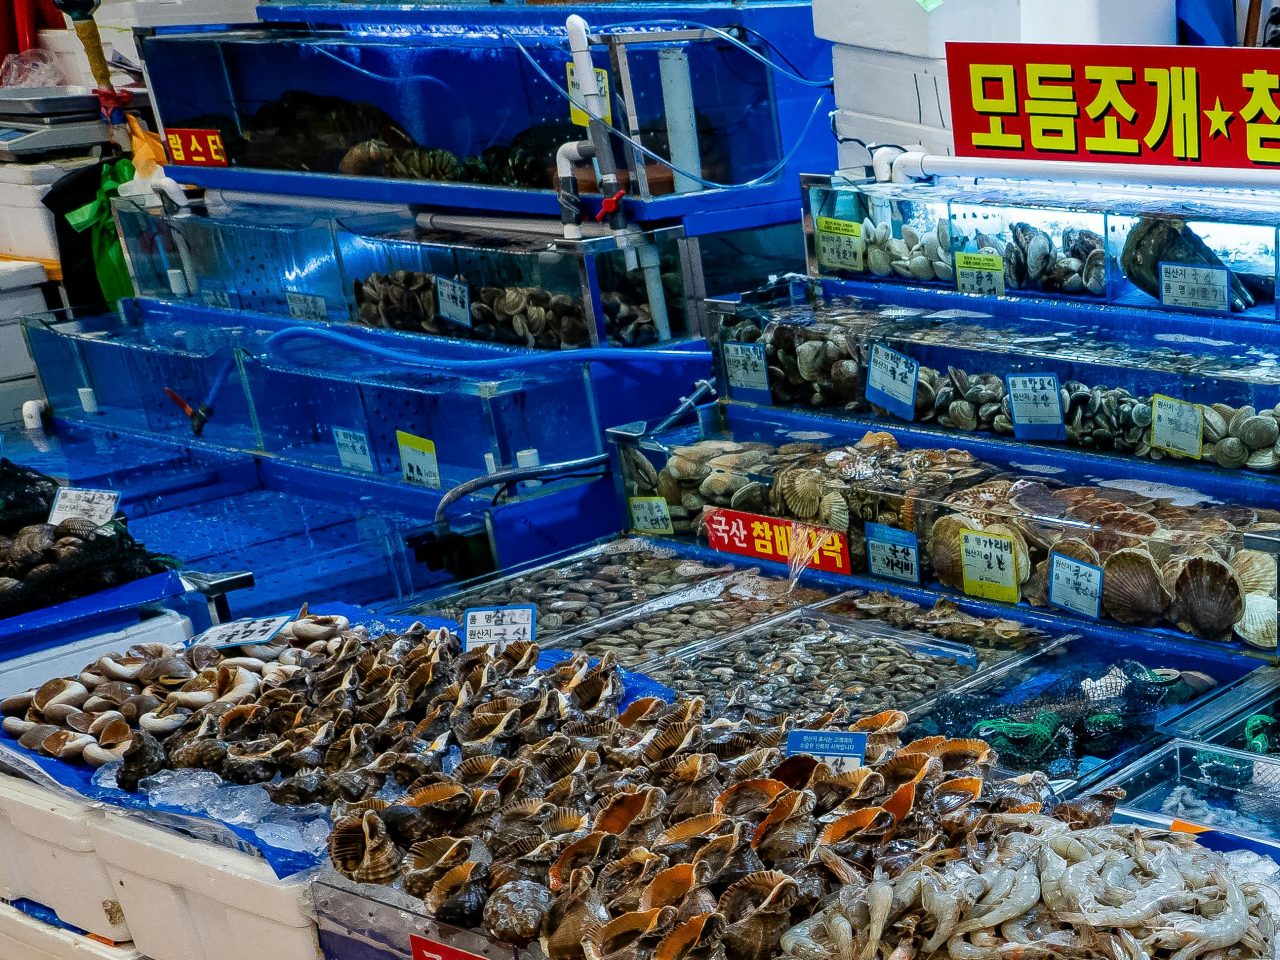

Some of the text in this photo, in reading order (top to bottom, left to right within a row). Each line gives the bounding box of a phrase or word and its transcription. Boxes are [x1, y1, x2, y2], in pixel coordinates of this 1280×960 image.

[969, 63, 1199, 159] 모듬조개
[167, 133, 226, 162] 랍스터
[1164, 267, 1186, 279] 원산지
[712, 516, 747, 548] 국산
[965, 548, 983, 559] 원산지
[982, 538, 1013, 554] 가리비
[886, 556, 914, 575] 가리비
[1055, 560, 1072, 571] 원산지
[469, 628, 492, 640] 원산지
